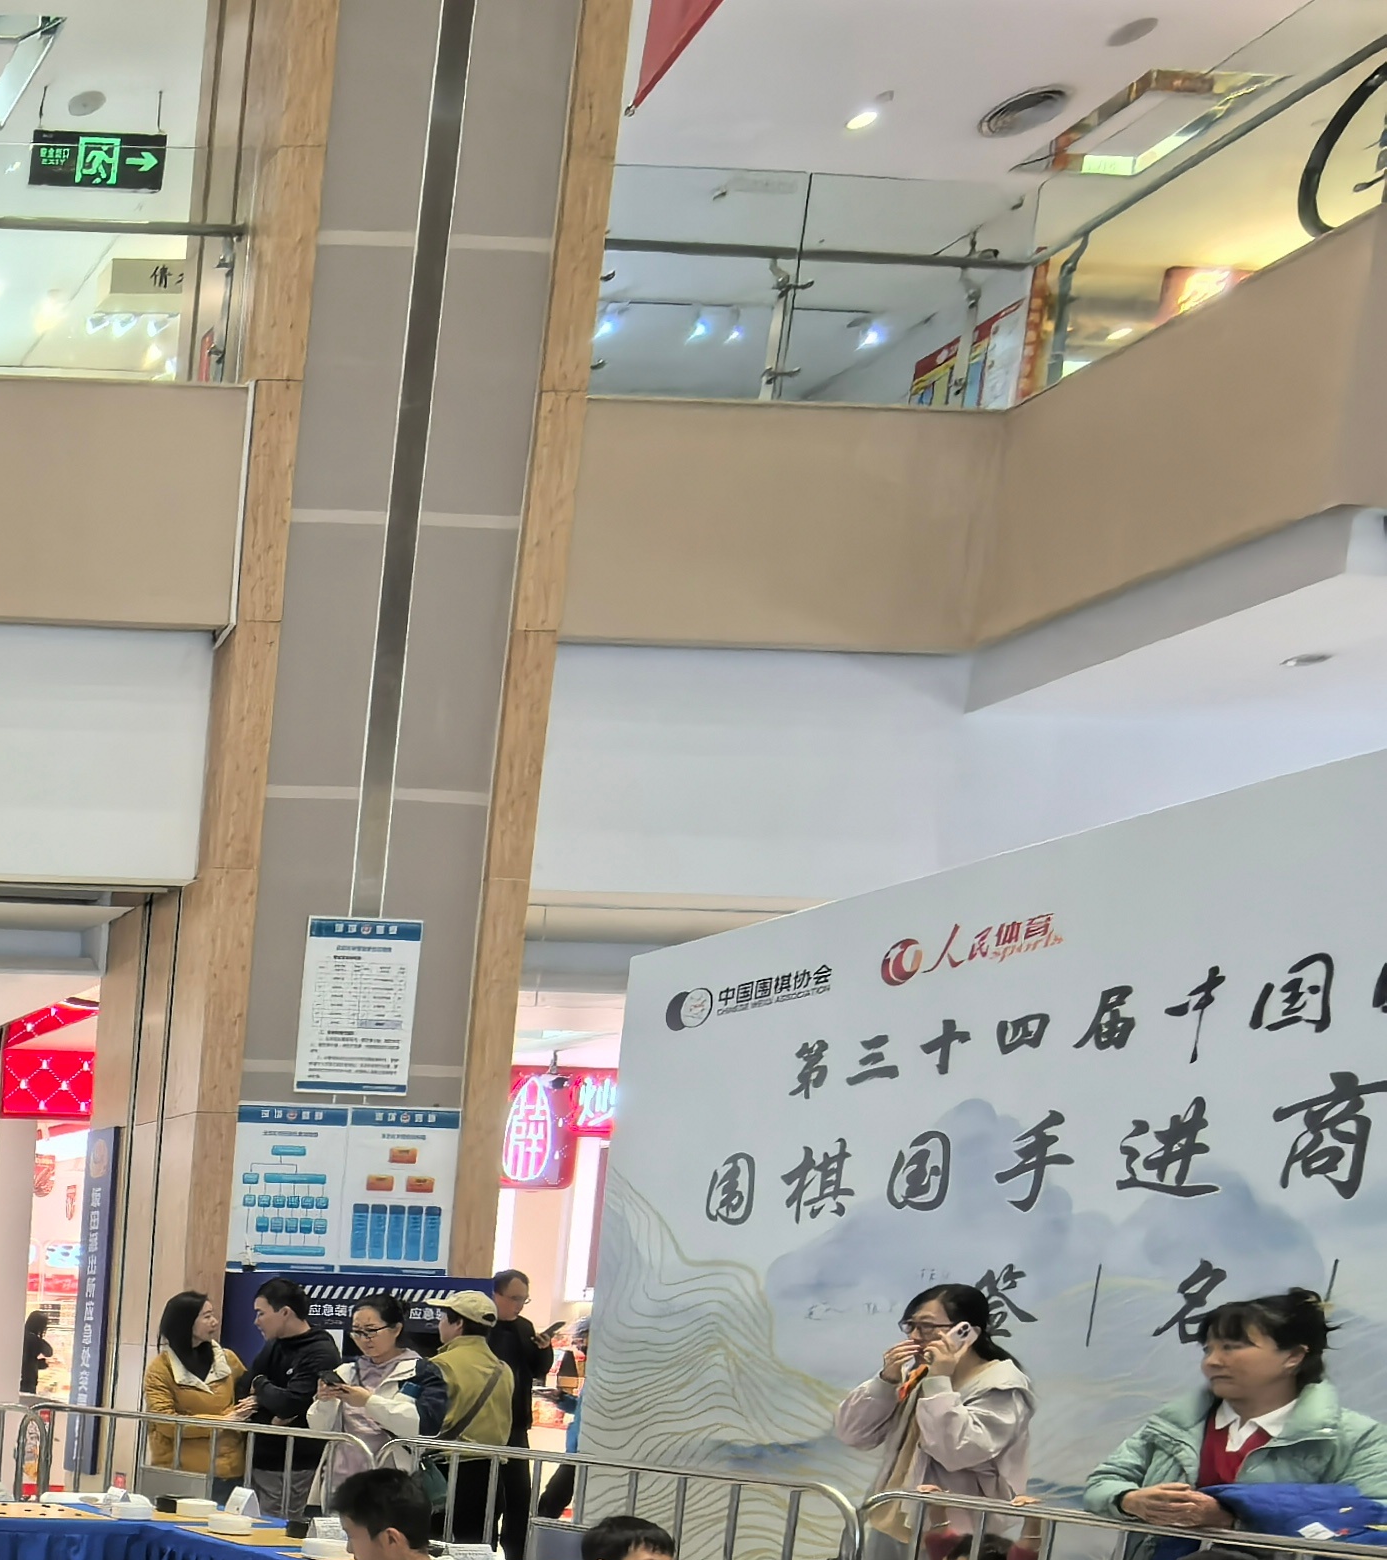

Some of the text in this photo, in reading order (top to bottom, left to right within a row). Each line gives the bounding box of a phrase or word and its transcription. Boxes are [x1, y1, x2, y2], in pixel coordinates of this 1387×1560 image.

[717, 964, 833, 1008] 中国围棋协会
[789, 952, 1387, 1099] 第三十四届中国
[705, 1071, 1387, 1226] 围棋国手进商
